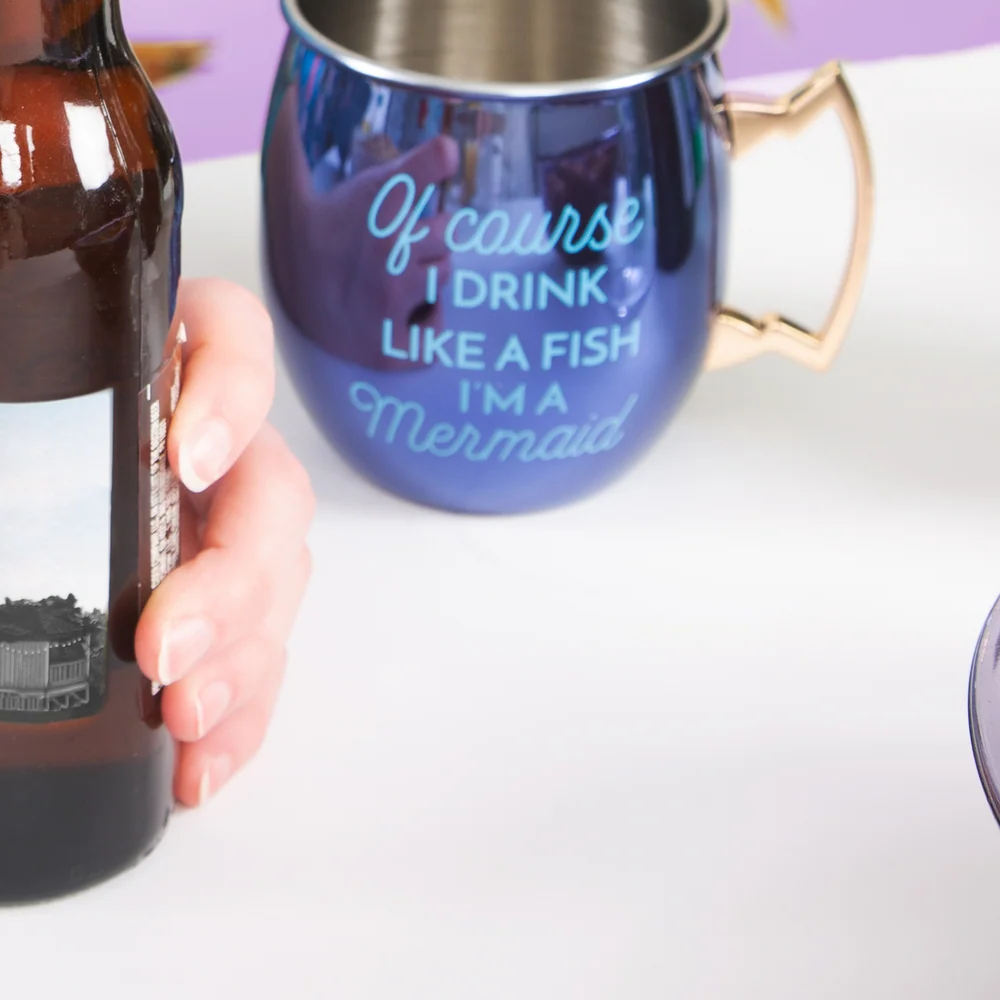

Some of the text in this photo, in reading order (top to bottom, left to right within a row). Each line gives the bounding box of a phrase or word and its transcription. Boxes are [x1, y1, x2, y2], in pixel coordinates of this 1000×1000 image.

[367, 173, 645, 276] Of course
[426, 265, 609, 311] I DRINK
[381, 318, 640, 372] LIKE A FISH
[349, 381, 640, 462] Mermaid
[459, 379, 569, 416] I'M A
